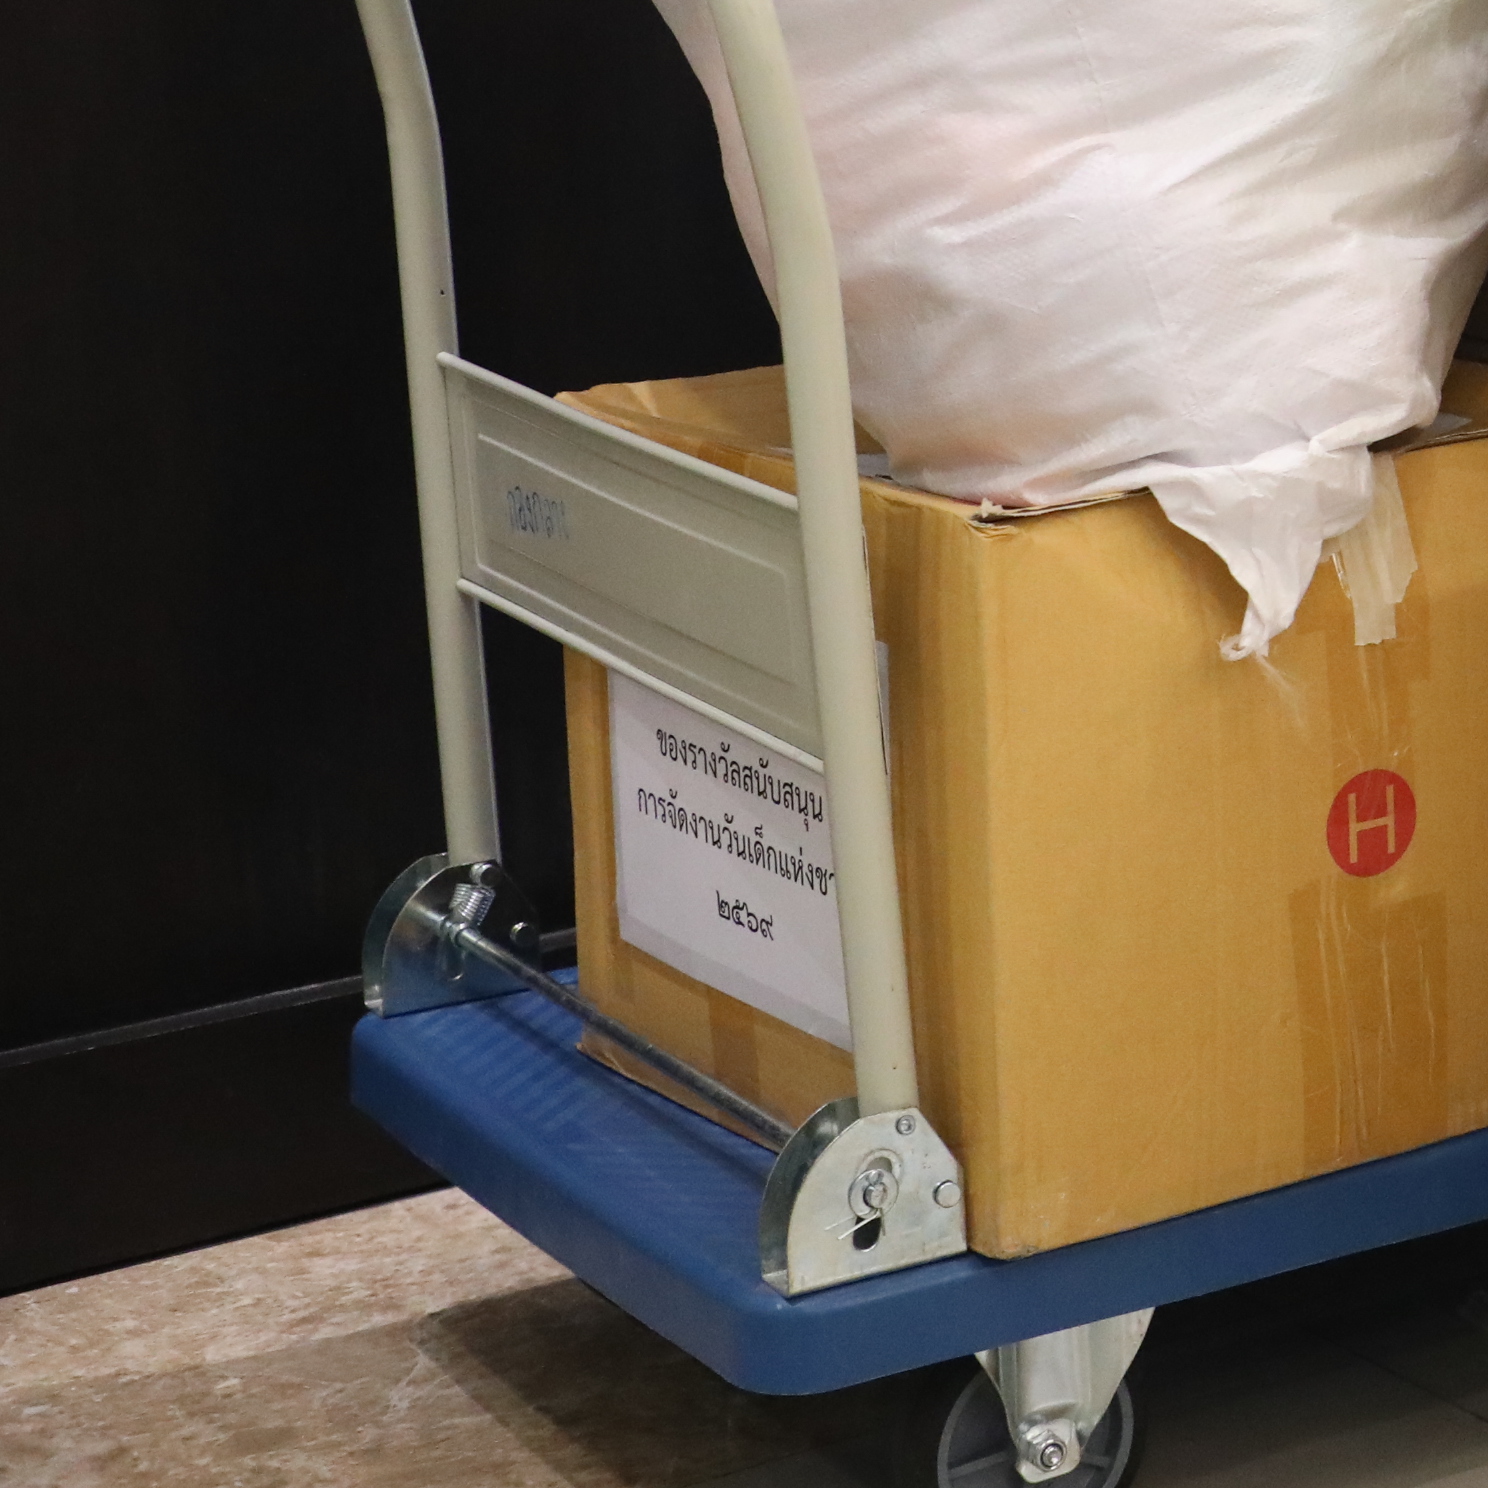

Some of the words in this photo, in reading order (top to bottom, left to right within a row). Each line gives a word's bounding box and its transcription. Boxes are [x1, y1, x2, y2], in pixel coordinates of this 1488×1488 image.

[655, 727, 824, 835] ของรางวัลสนับสนุน
[1347, 784, 1396, 864] H
[714, 889, 774, 942] ๒๕๖๙
